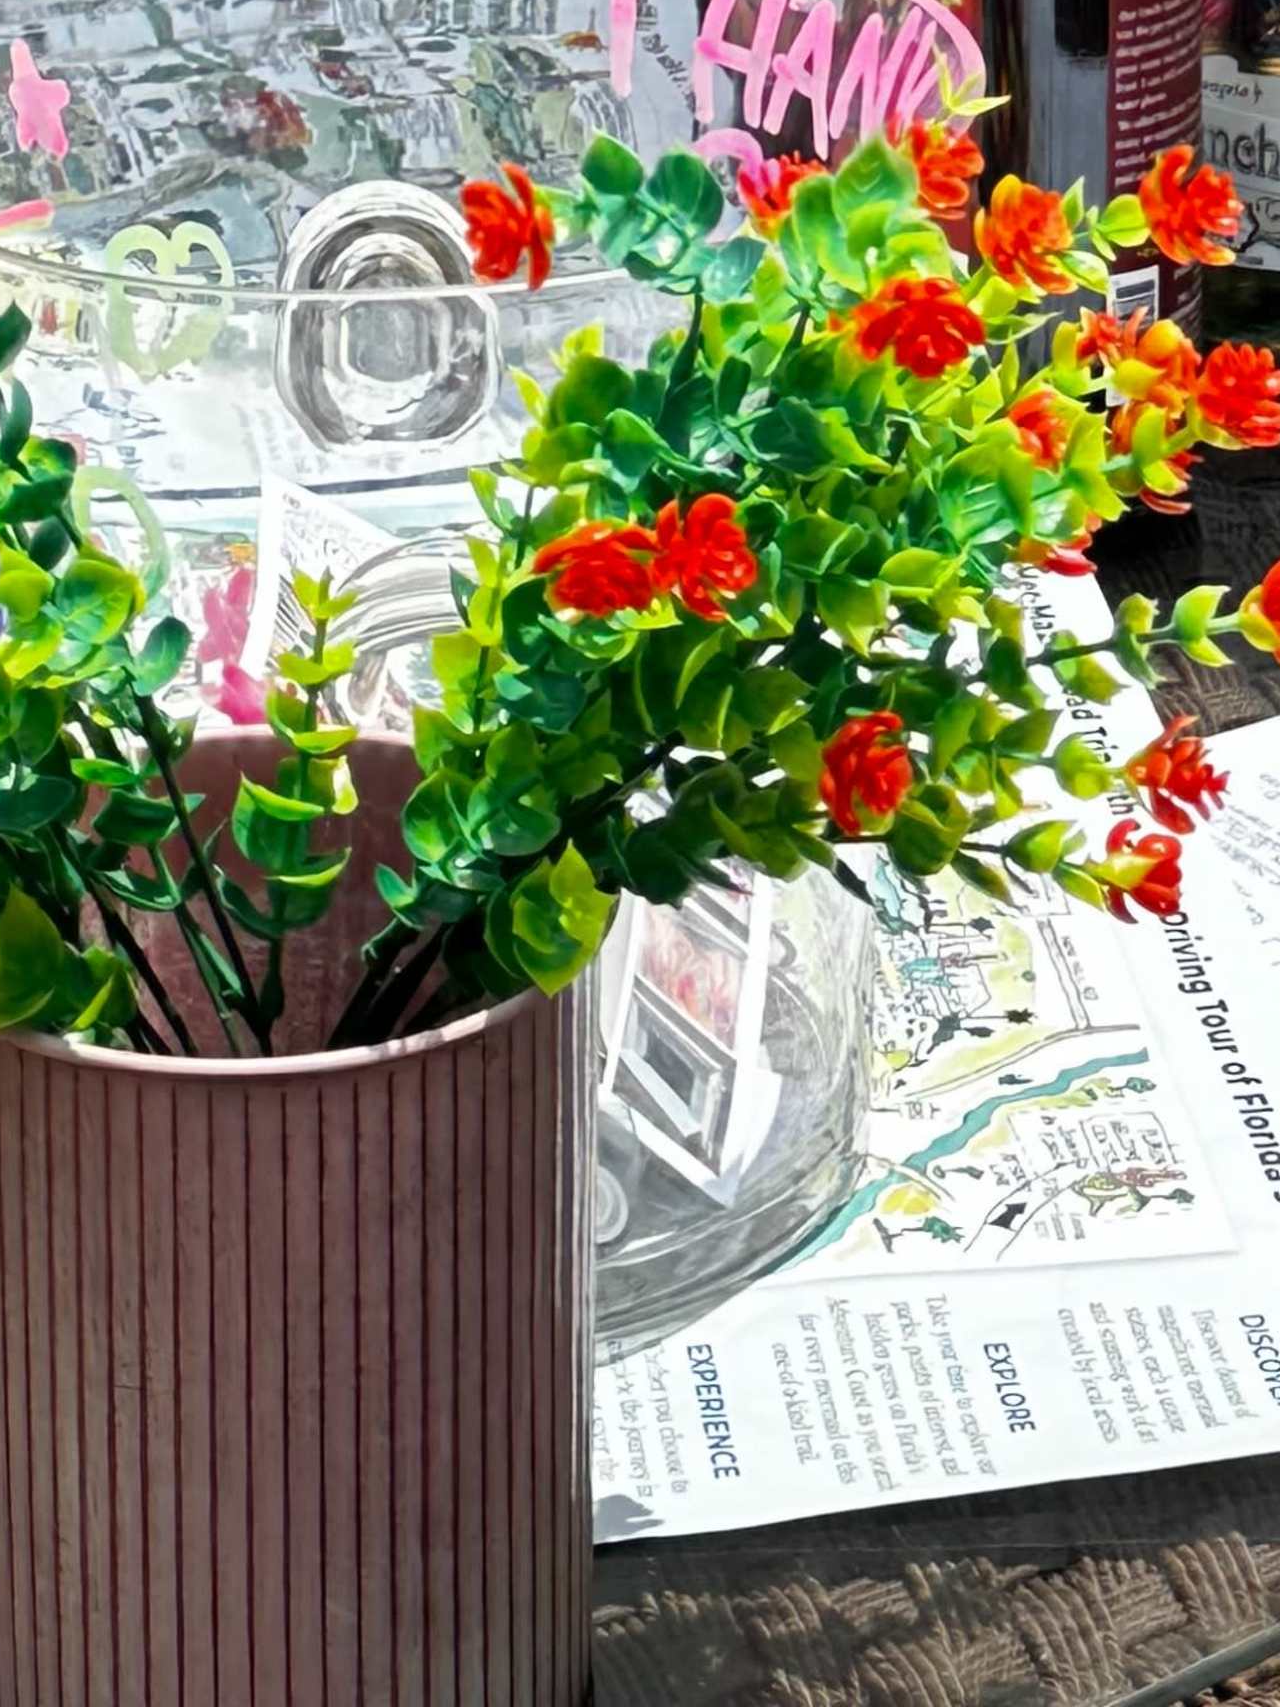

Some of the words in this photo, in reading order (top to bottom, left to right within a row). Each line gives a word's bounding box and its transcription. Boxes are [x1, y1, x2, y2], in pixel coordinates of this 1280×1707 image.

[1159, 911, 1213, 993] Driving
[1196, 999, 1238, 1053] Tour
[1221, 1062, 1262, 1085] of
[687, 1344, 740, 1479] EXPERIENCE
[984, 1343, 1036, 1433] EXPLORE
